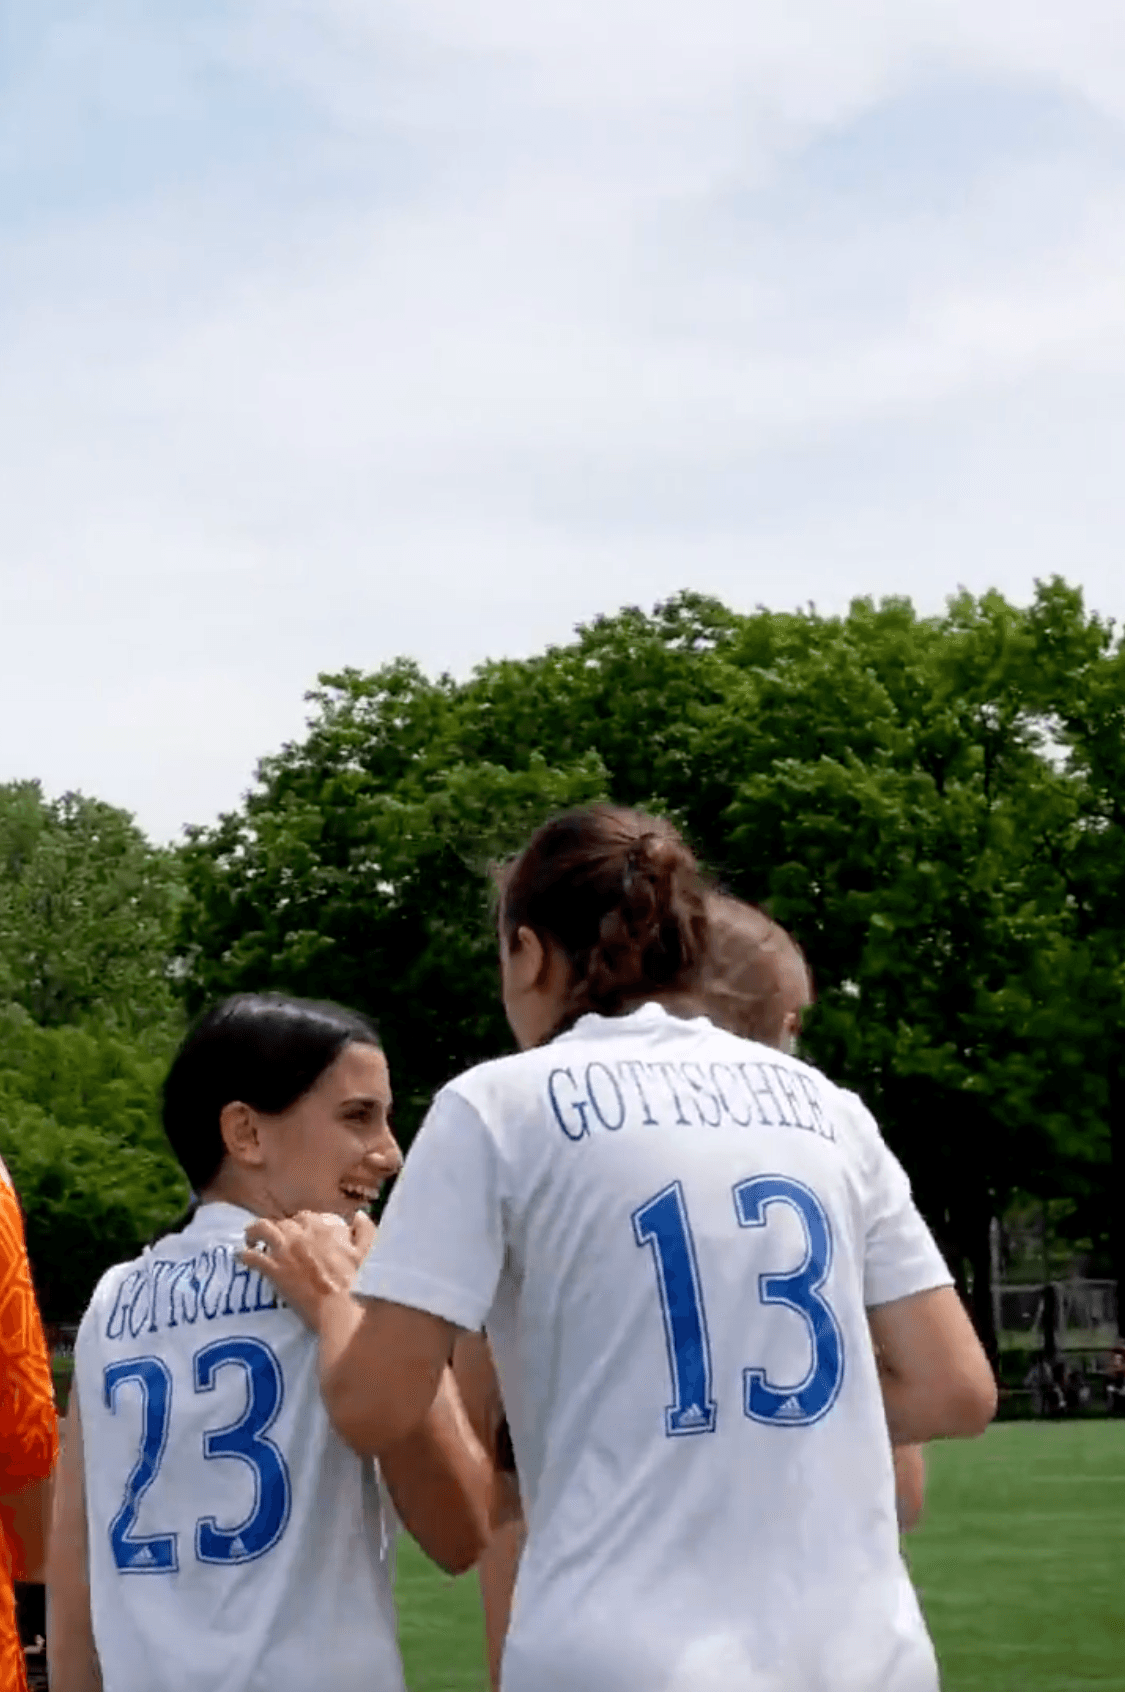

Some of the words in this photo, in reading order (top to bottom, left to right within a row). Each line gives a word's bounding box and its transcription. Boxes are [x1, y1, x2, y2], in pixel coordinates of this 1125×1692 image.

[548, 1060, 836, 1142] GOTTSCHEE
[105, 1244, 289, 1340] GOTTSCHE
[631, 1173, 845, 1437] 13
[103, 1336, 292, 1574] 23
